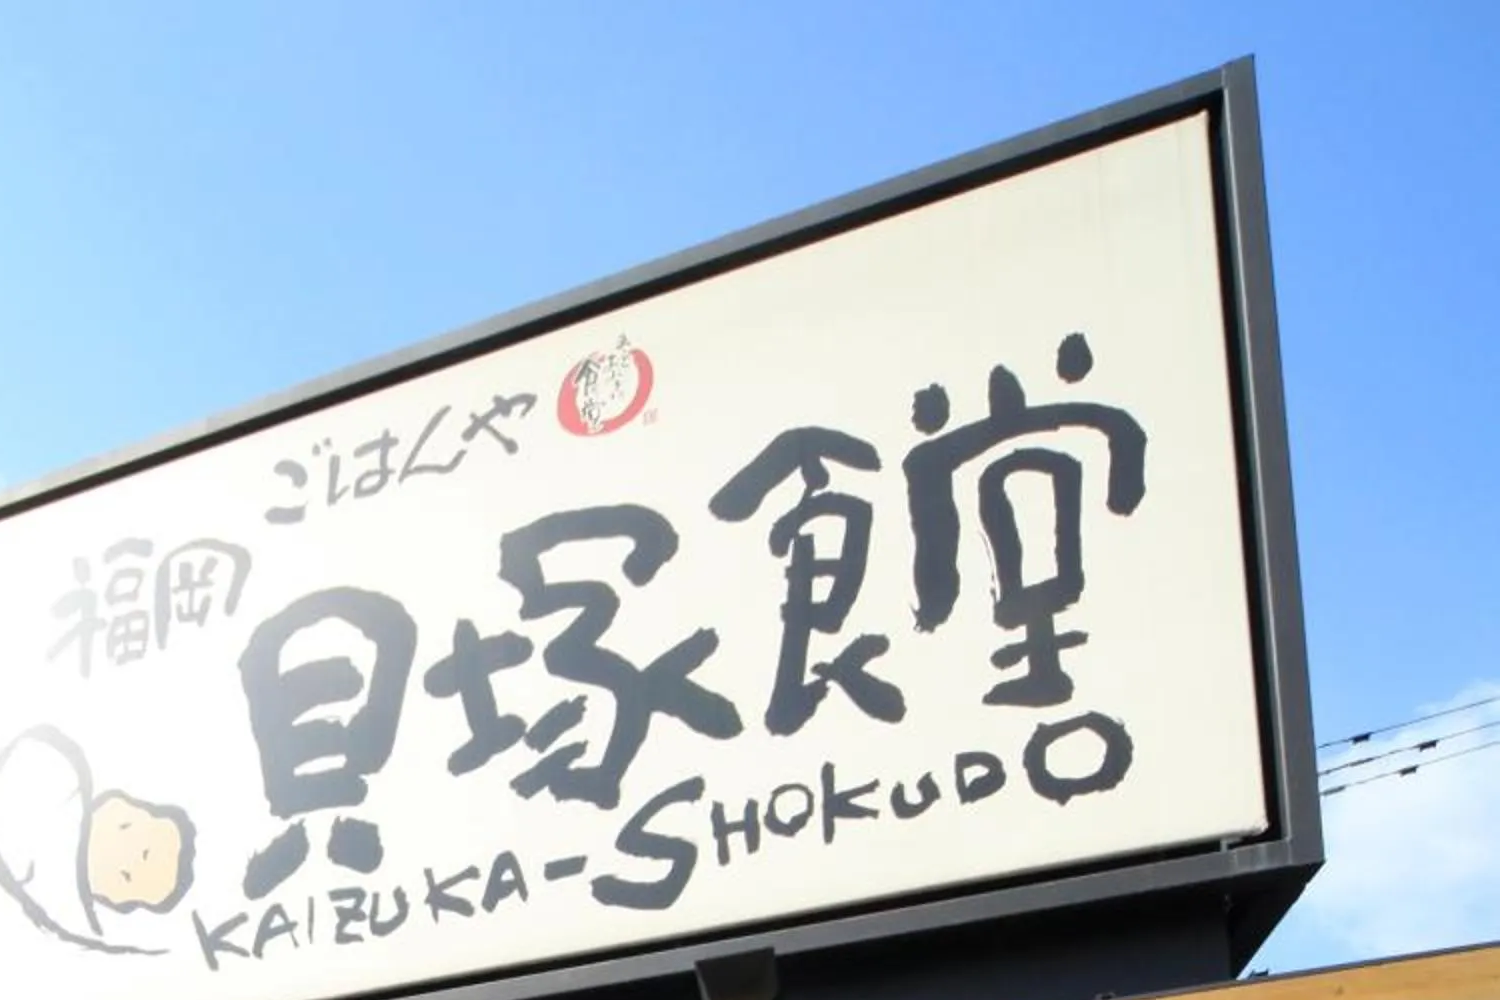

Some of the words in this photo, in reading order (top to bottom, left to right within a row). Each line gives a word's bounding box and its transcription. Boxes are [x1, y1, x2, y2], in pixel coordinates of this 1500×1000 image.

[263, 392, 538, 525] ごはんや
[45, 537, 252, 679] 福岡
[238, 332, 1148, 901] 貝塚食堂
[191, 712, 1134, 972] KAIZUKA-SHOKUDO
